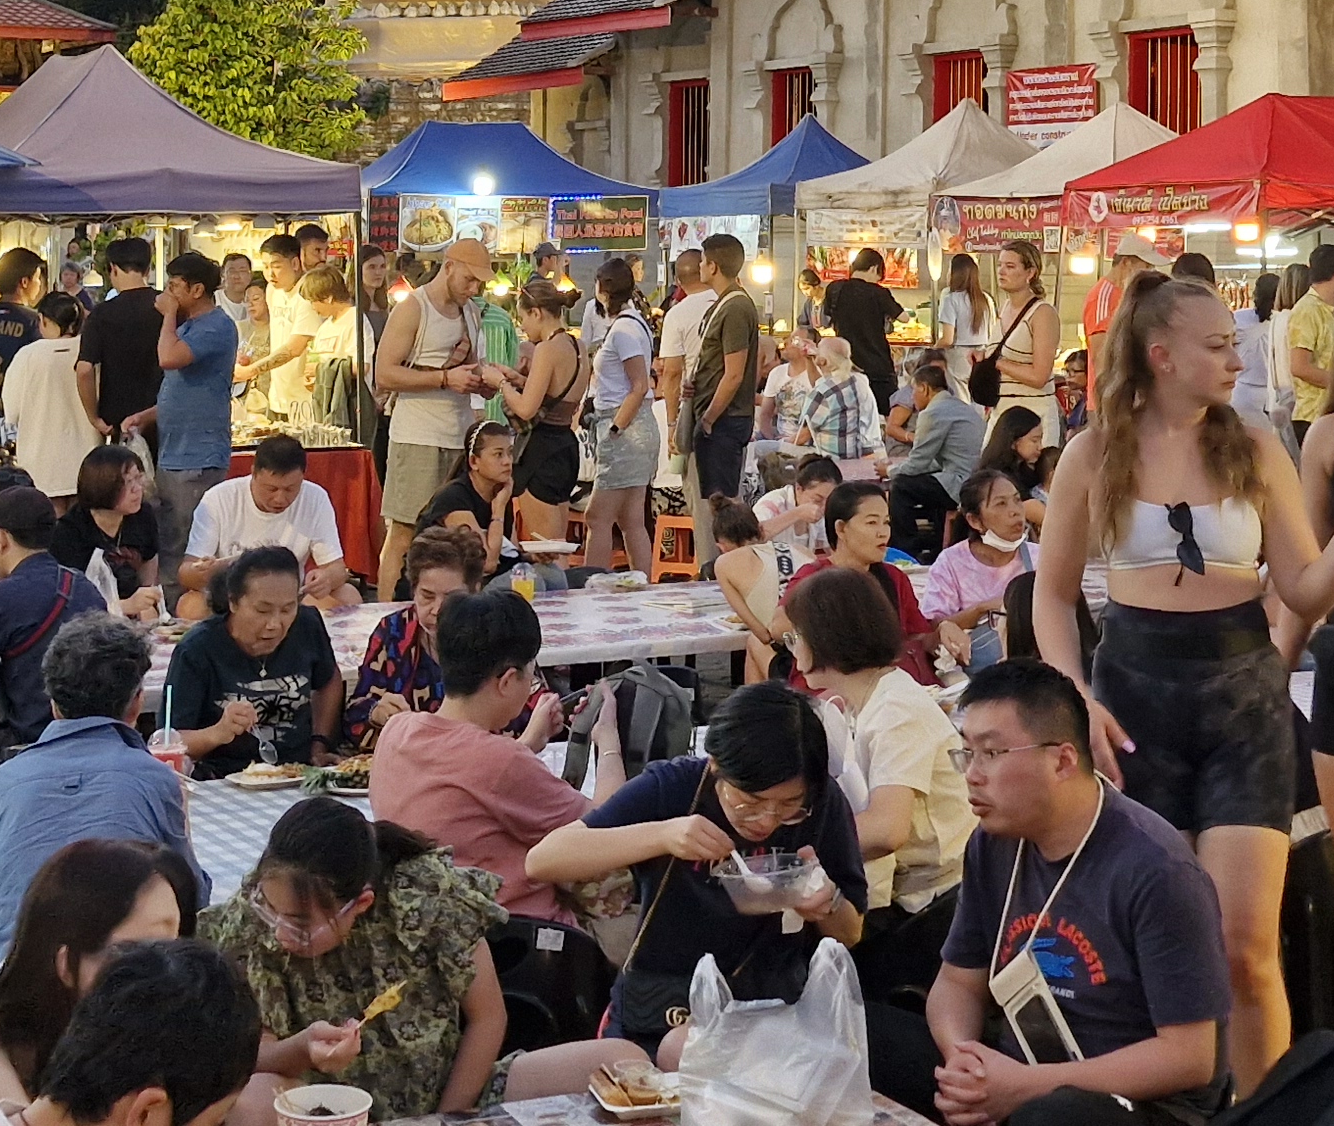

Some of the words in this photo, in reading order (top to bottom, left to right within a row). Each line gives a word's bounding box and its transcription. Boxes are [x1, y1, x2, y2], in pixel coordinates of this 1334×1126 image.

[1040, 130, 1072, 141] constr
[962, 198, 1038, 228] ทอดมันกุ้ง
[1056, 916, 1107, 987] LACOSTE
